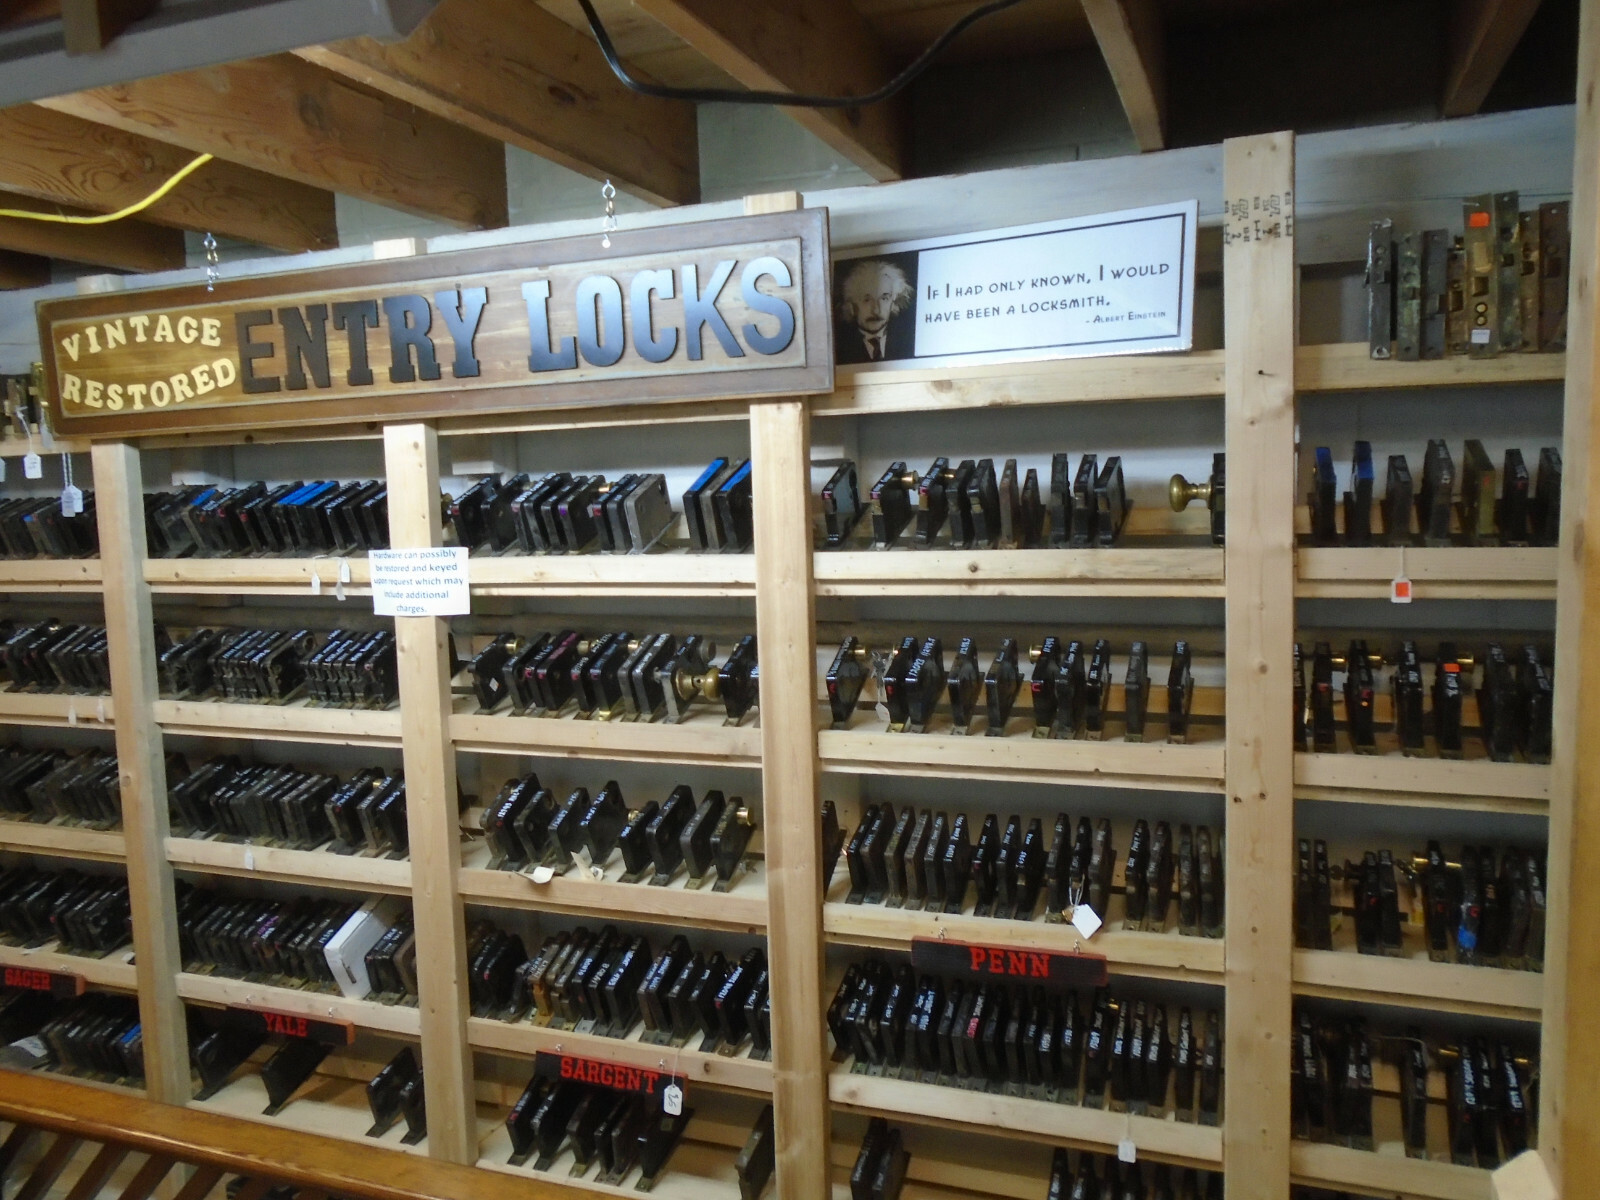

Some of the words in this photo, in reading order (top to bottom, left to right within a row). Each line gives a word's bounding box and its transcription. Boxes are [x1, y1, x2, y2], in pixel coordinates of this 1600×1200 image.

[945, 283, 950, 299] I
[989, 279, 1025, 294] ONLY
[1099, 264, 1104, 282] I
[1110, 263, 1170, 279] WOULD
[925, 310, 960, 324] HAVE
[966, 305, 1000, 320] BEEN
[1006, 304, 1016, 315] A
[1021, 295, 1111, 314] LOCKSMITH.
[61, 314, 222, 362] VINTAGE
[234, 286, 488, 395] ENTRY
[521, 256, 796, 373] LOCKS
[62, 358, 237, 411] RESTORED
[384, 564, 410, 572] restored
[430, 563, 458, 573] keyed
[420, 549, 457, 559] possibly
[406, 590, 449, 599] additional
[444, 578, 464, 586] may
[396, 605, 428, 614] charges.
[968, 945, 1050, 978] PENN
[262, 1012, 308, 1037] YALE
[560, 1057, 659, 1095] SARGENT
